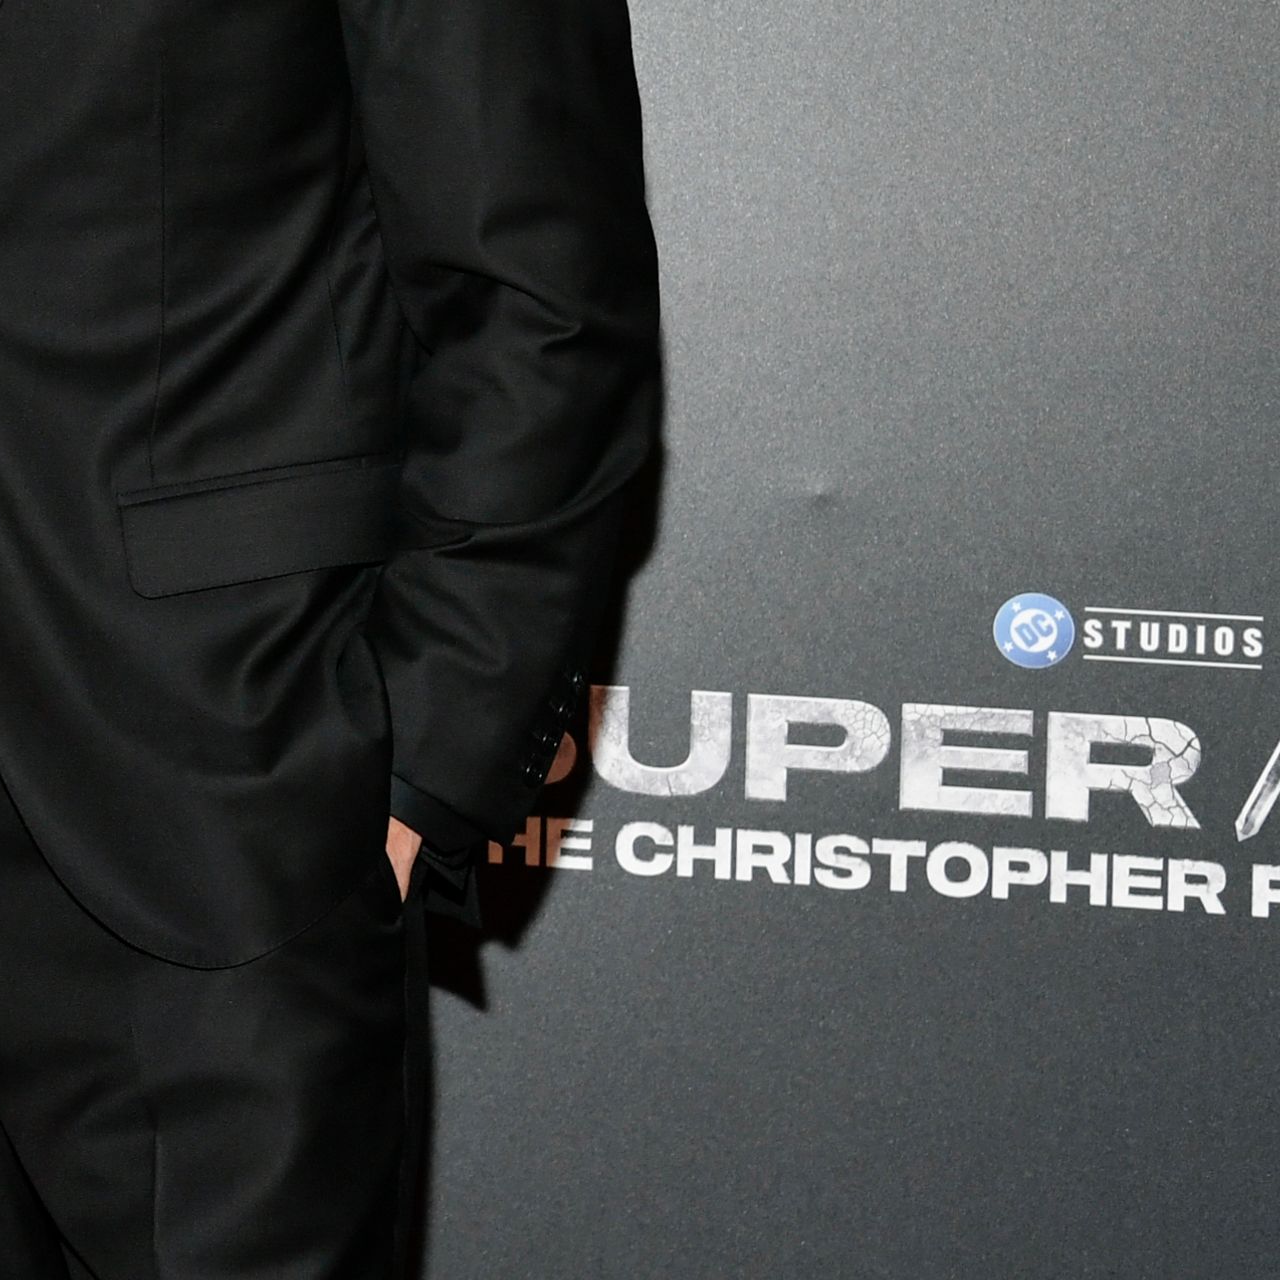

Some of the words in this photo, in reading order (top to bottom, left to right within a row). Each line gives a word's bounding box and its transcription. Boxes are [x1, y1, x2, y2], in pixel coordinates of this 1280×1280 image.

[1083, 618, 1263, 658] STUDIOS
[488, 816, 594, 871] HE
[615, 820, 1227, 915] CHRISTOPHER
